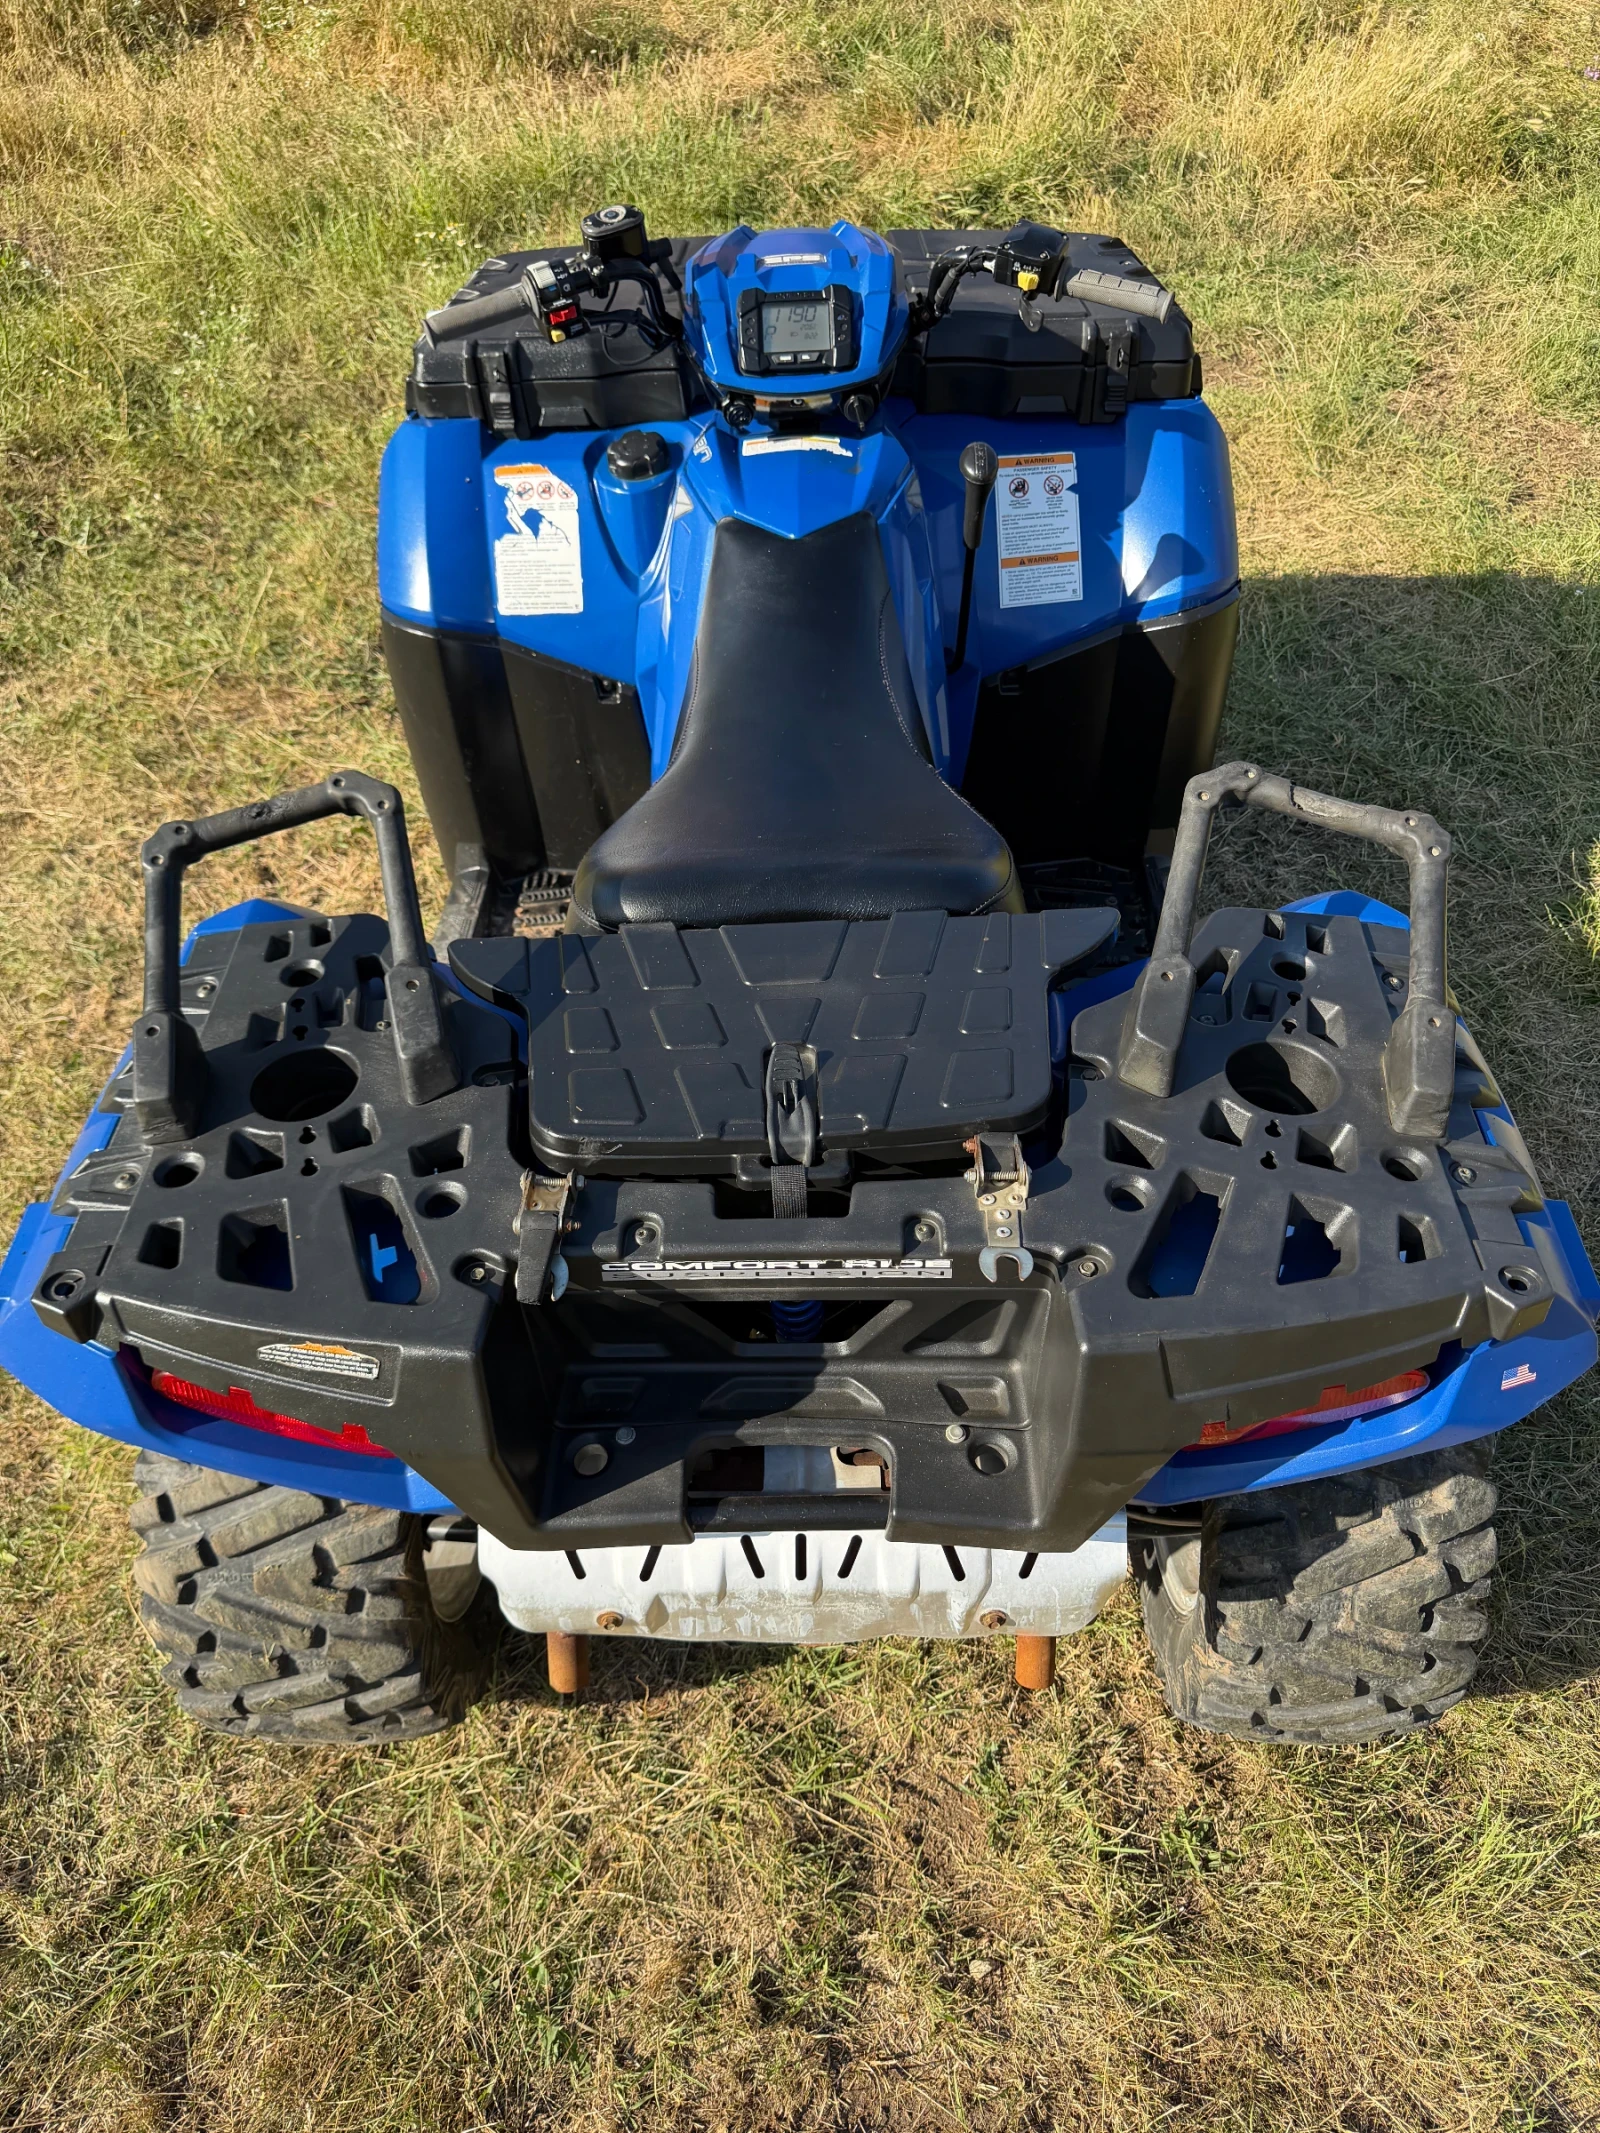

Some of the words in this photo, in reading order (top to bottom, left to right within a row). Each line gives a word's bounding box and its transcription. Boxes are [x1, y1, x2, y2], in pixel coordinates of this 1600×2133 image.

[775, 305, 818, 323] 1190
[1024, 457, 1055, 465] WARNING
[1027, 555, 1059, 564] WARNING
[602, 1260, 824, 1271] COMFORT
[845, 1259, 951, 1269] RIDE
[612, 1271, 945, 1279] SUSPENSION
